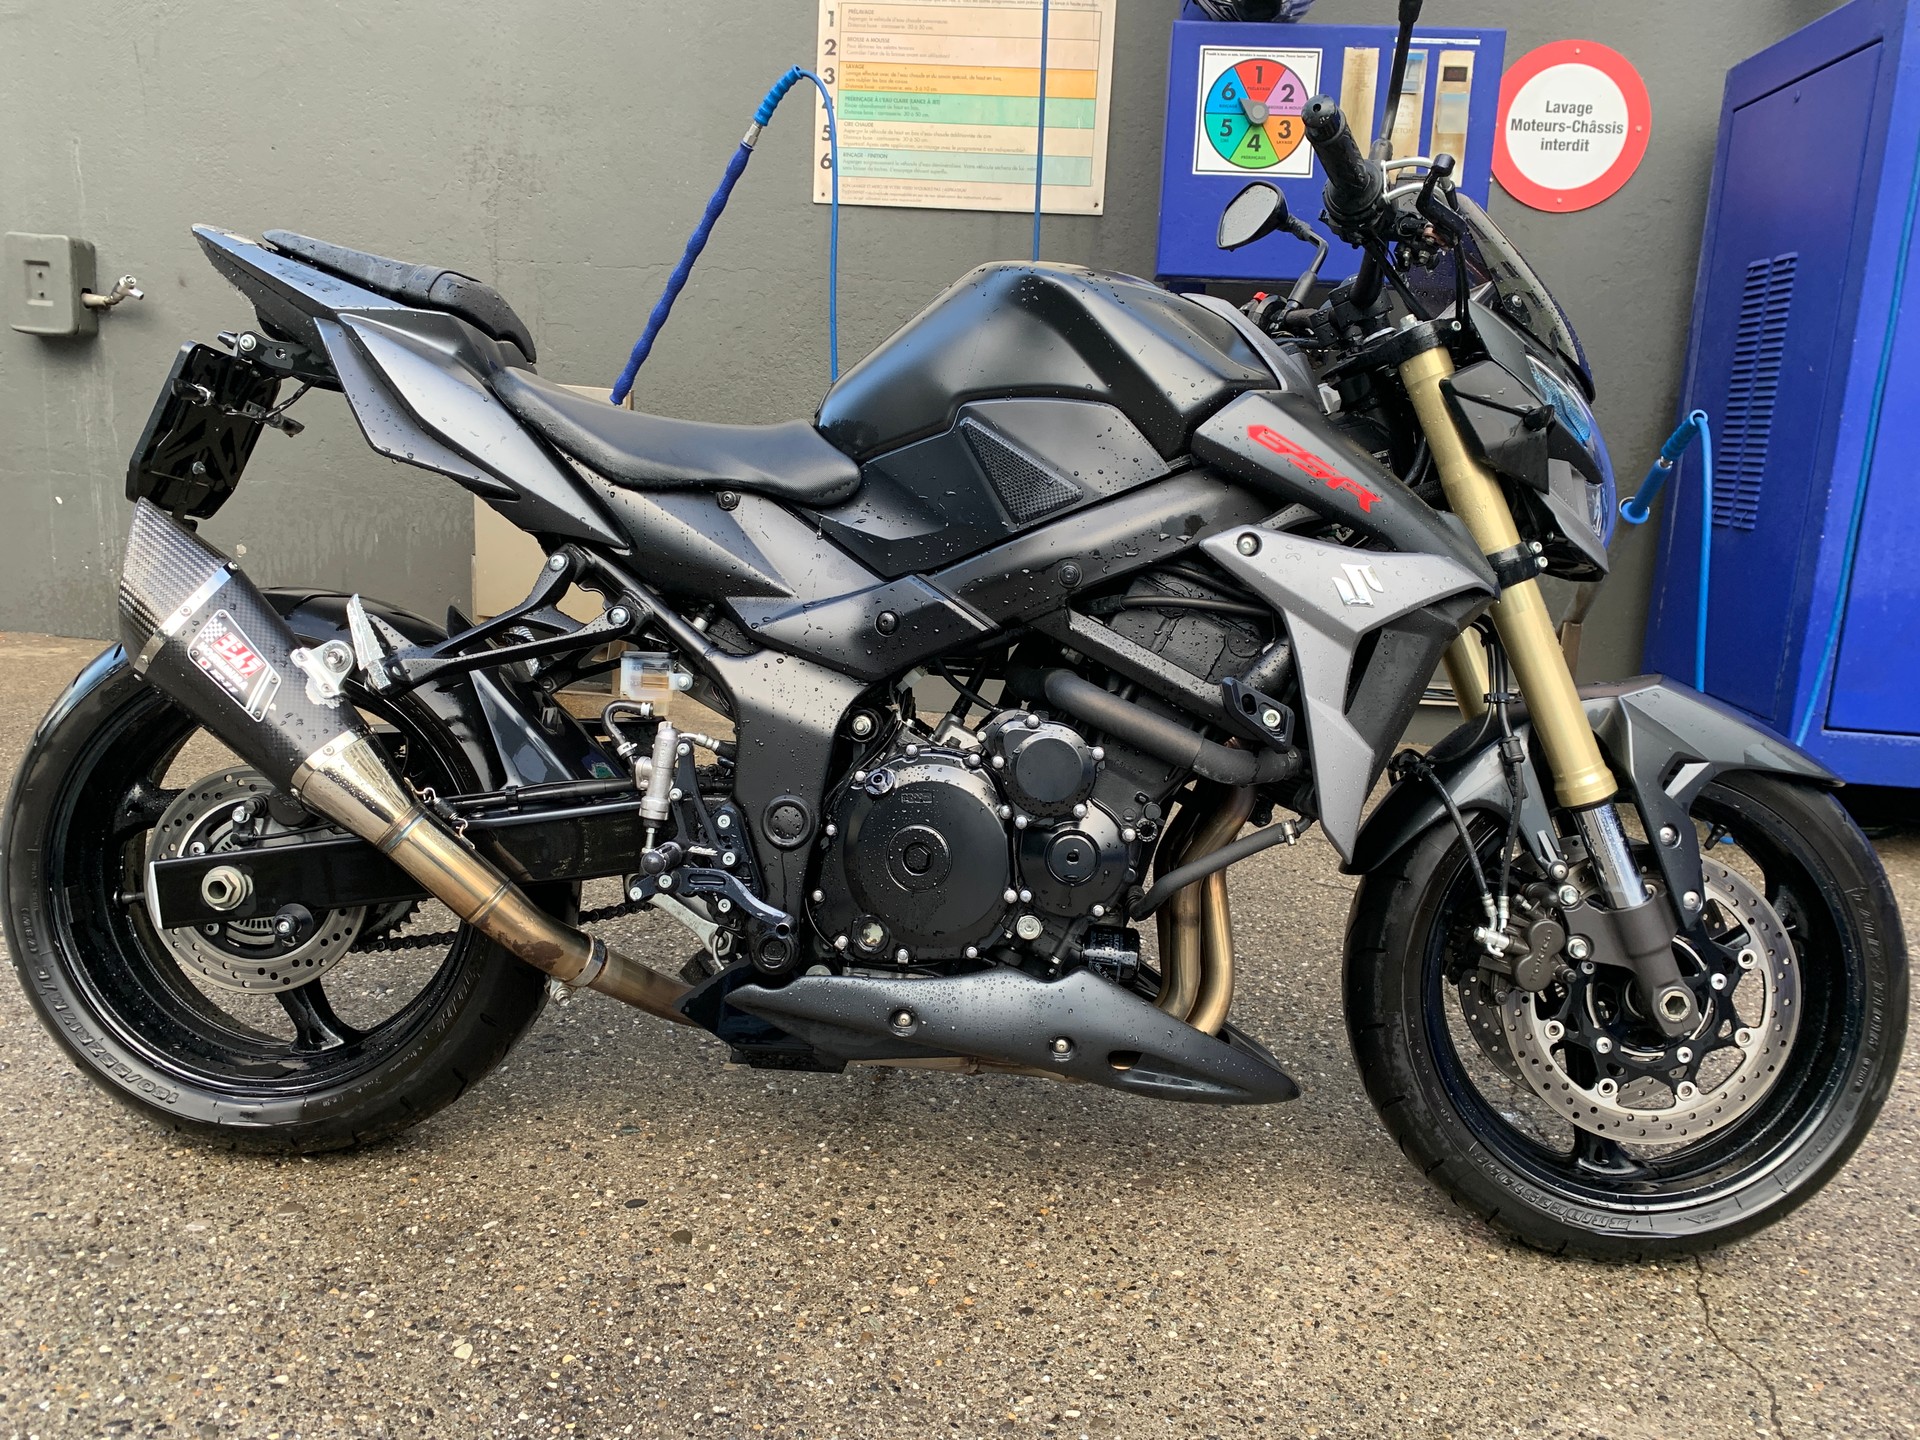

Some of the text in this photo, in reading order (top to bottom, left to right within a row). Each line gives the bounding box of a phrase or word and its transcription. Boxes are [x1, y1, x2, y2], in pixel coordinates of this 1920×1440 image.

[828, 10, 834, 27] 1
[824, 38, 837, 56] 2
[823, 68, 835, 84] 3
[1256, 66, 1263, 84] 1
[1222, 82, 1236, 100] 6
[1280, 84, 1294, 102] 2
[1545, 100, 1593, 116] Lavage
[822, 124, 831, 141] 5
[1220, 119, 1232, 137] 5
[1278, 120, 1291, 139] 3
[1510, 118, 1624, 134] Moteurs-Châssis
[1247, 134, 1261, 152] 4
[1540, 138, 1590, 152] interdit
[821, 153, 832, 169] 6
